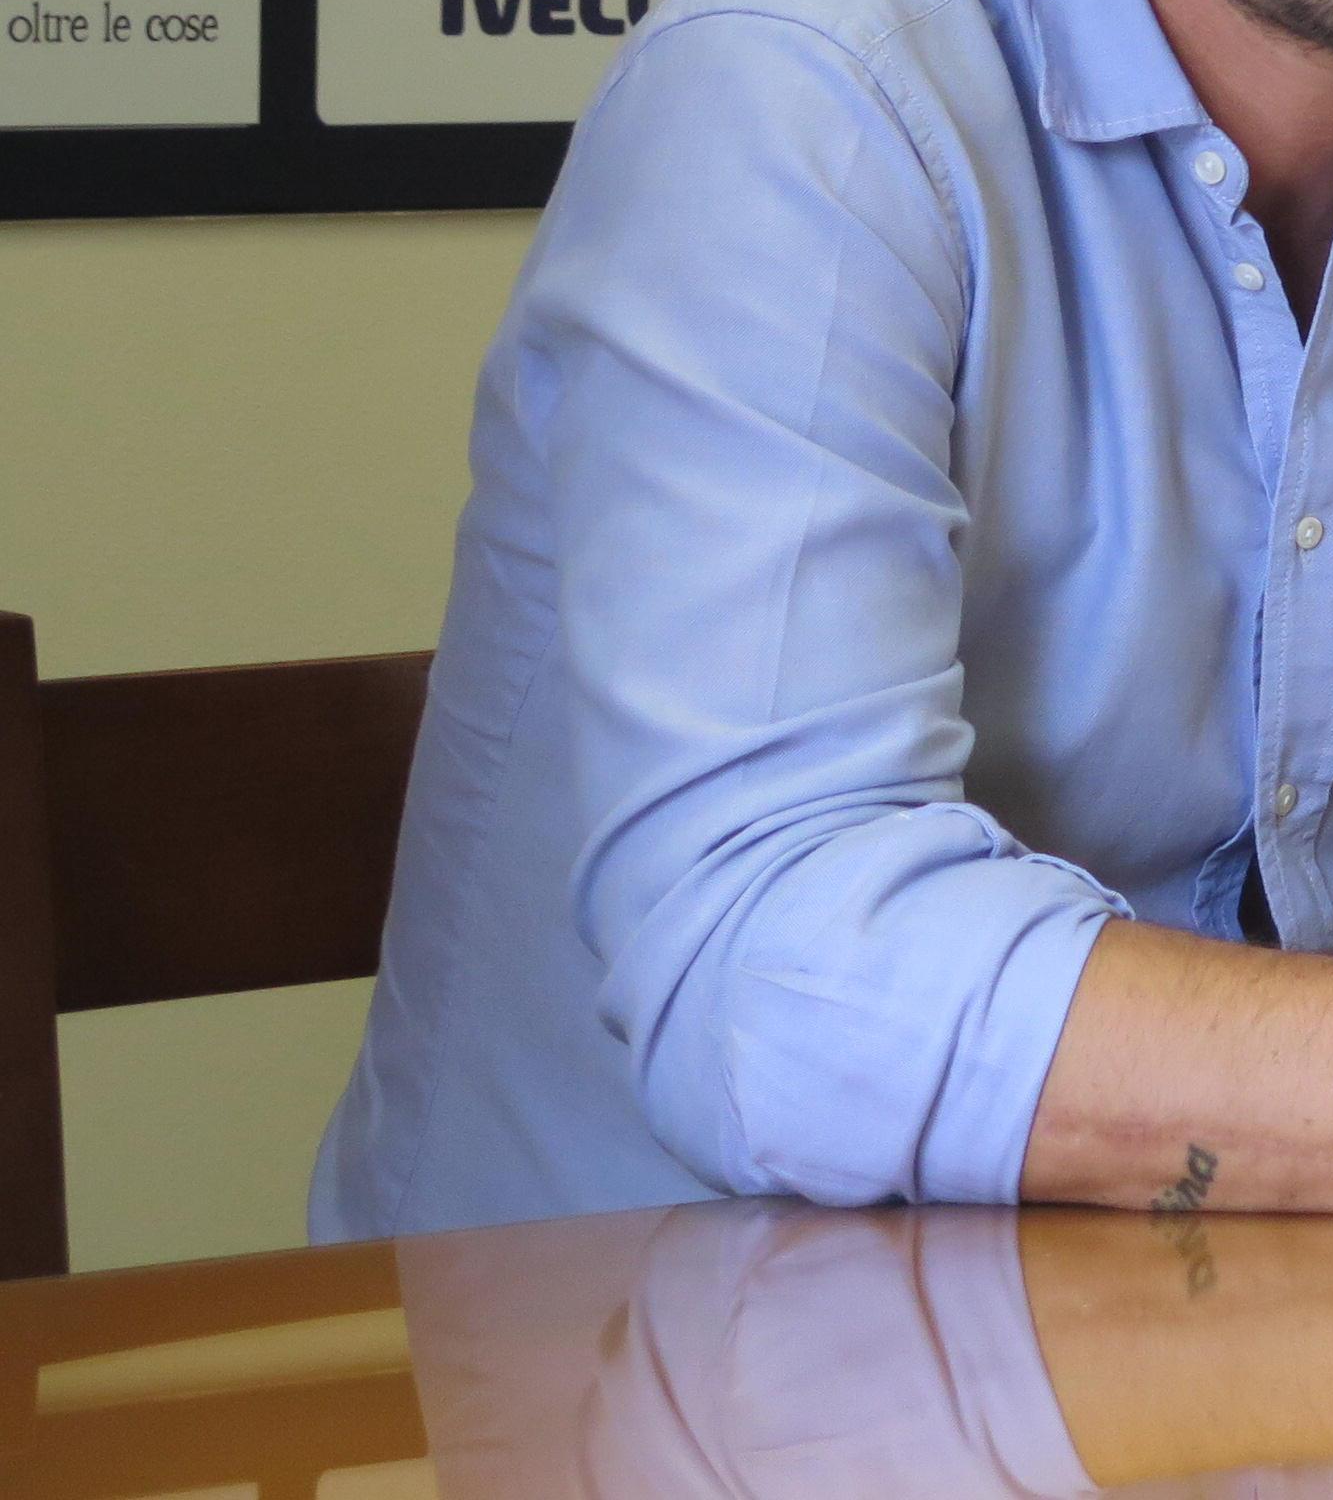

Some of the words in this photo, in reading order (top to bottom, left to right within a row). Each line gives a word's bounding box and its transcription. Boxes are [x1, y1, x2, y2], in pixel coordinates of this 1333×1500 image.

[8, 1, 89, 43] oltre
[104, 1, 131, 43] le
[146, 14, 219, 42] cose
